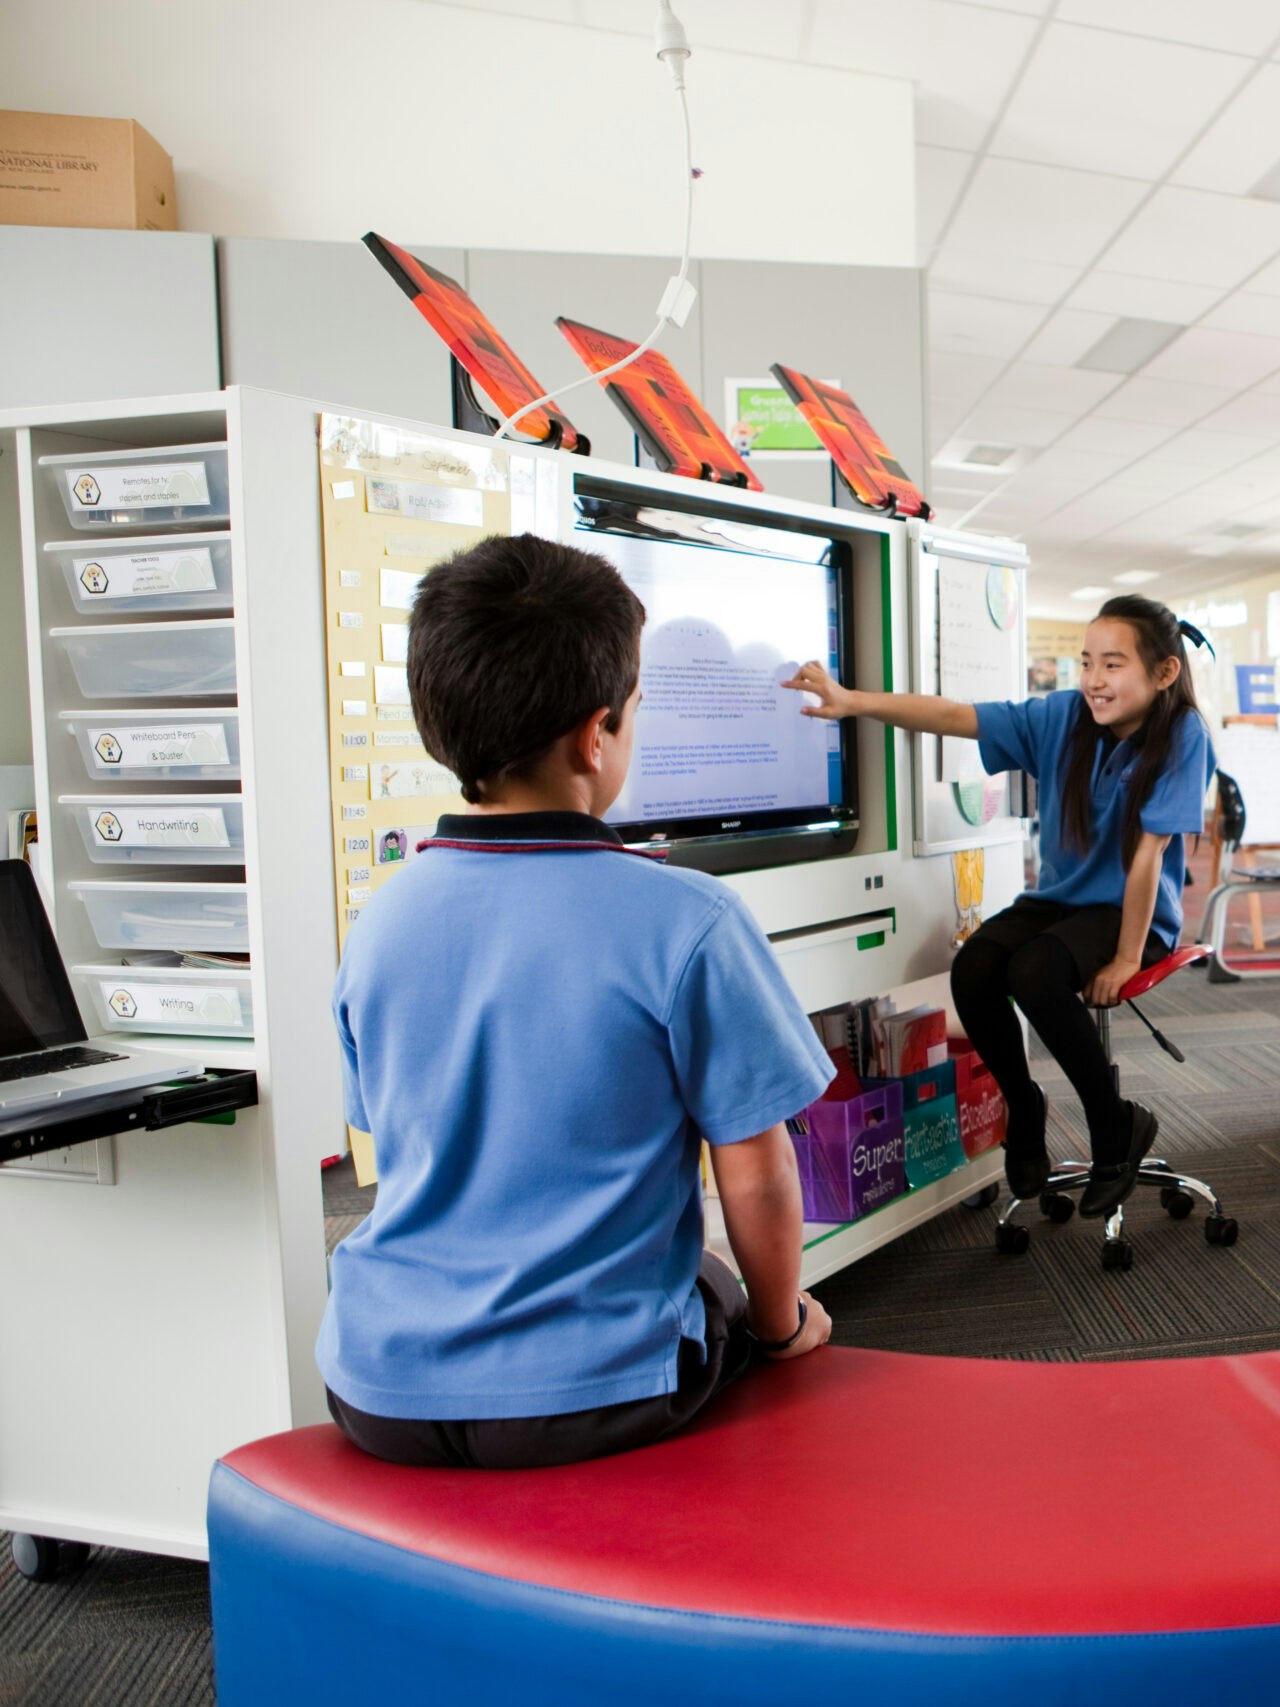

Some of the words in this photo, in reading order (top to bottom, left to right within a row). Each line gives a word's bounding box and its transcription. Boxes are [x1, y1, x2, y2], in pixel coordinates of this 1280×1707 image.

[56, 159, 99, 172] LIBRARY
[143, 492, 156, 501] and
[130, 731, 176, 741] Whiteboard
[177, 730, 196, 739] Pens
[344, 735, 368, 745] 11:00
[151, 752, 158, 760] &
[159, 751, 183, 760] Duster
[344, 807, 366, 817] 11:45
[137, 818, 199, 833] Handwriting
[348, 839, 369, 850] 12:00
[159, 997, 194, 1012] Writing
[852, 1137, 903, 1181] Super
